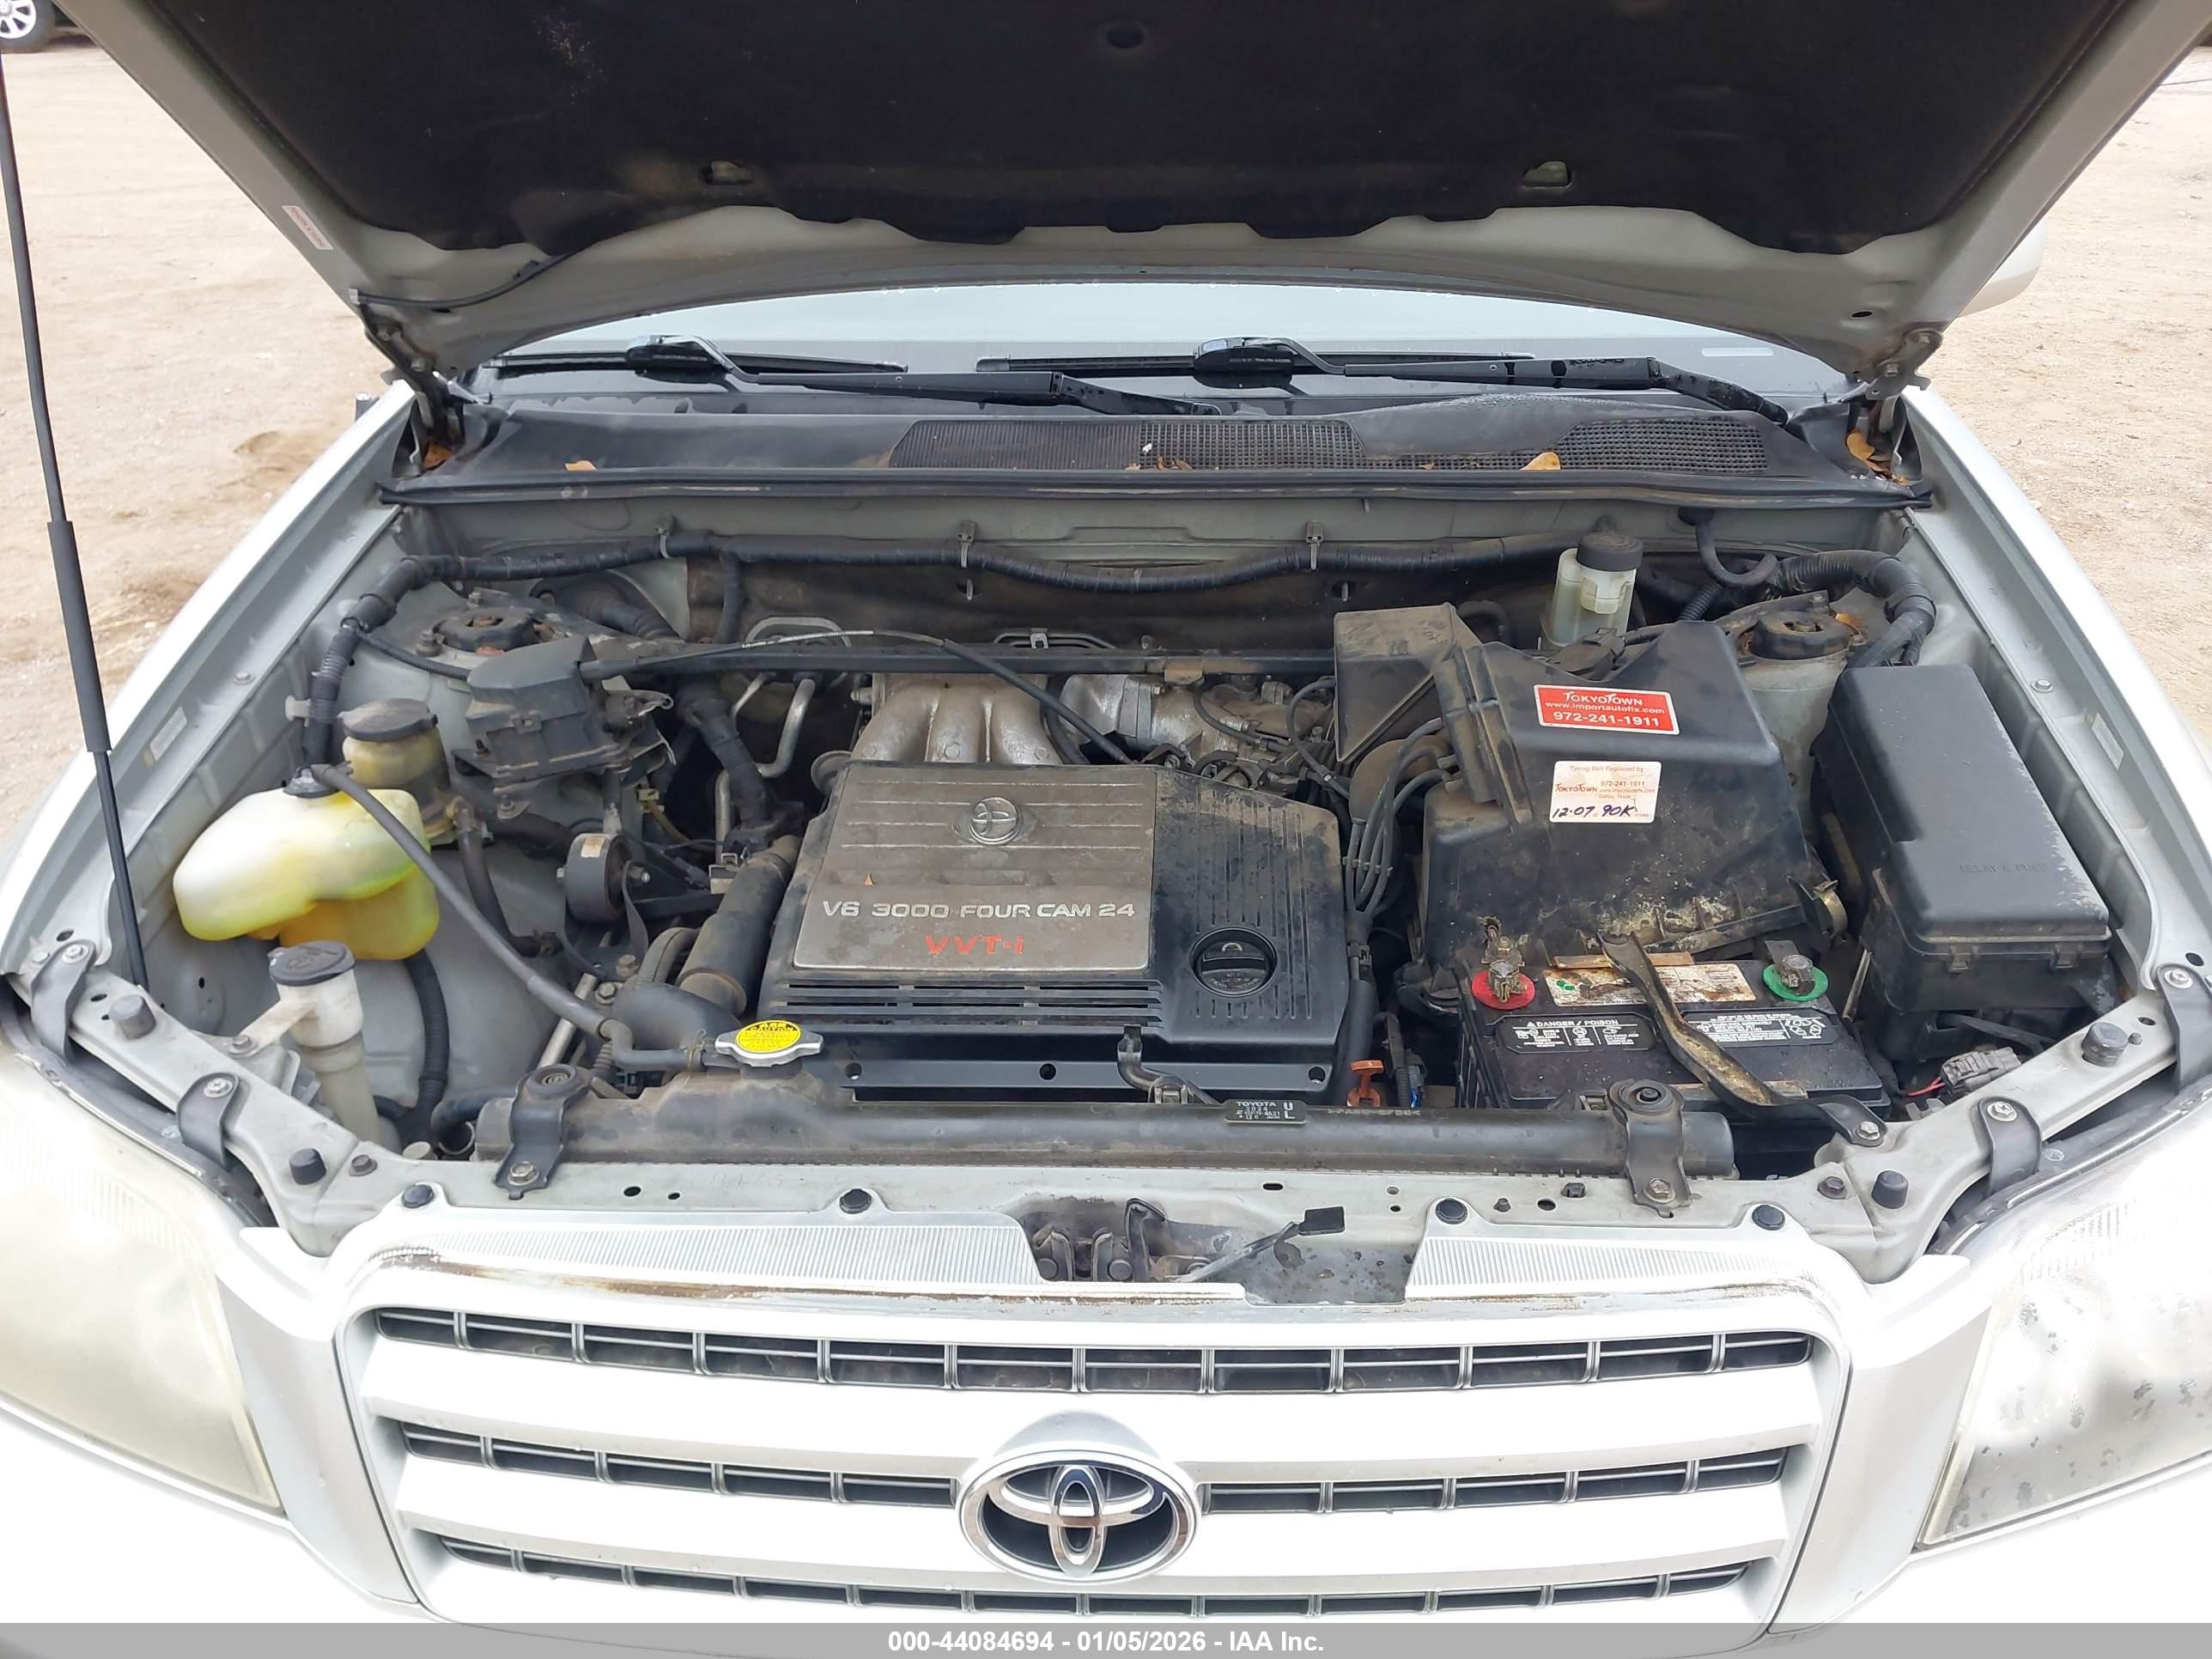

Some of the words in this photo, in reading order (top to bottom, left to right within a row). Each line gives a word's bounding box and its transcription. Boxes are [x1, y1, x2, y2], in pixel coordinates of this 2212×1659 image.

[1545, 702, 1665, 714] www.importautofix.com
[1553, 711, 1660, 726] 972-241-1911
[1601, 805, 1636, 817] 90K
[823, 901, 860, 917] V6
[872, 902, 949, 919] 3000
[959, 903, 1030, 918] FOUR
[1036, 902, 1091, 918] CAM
[1098, 902, 1135, 918] 24
